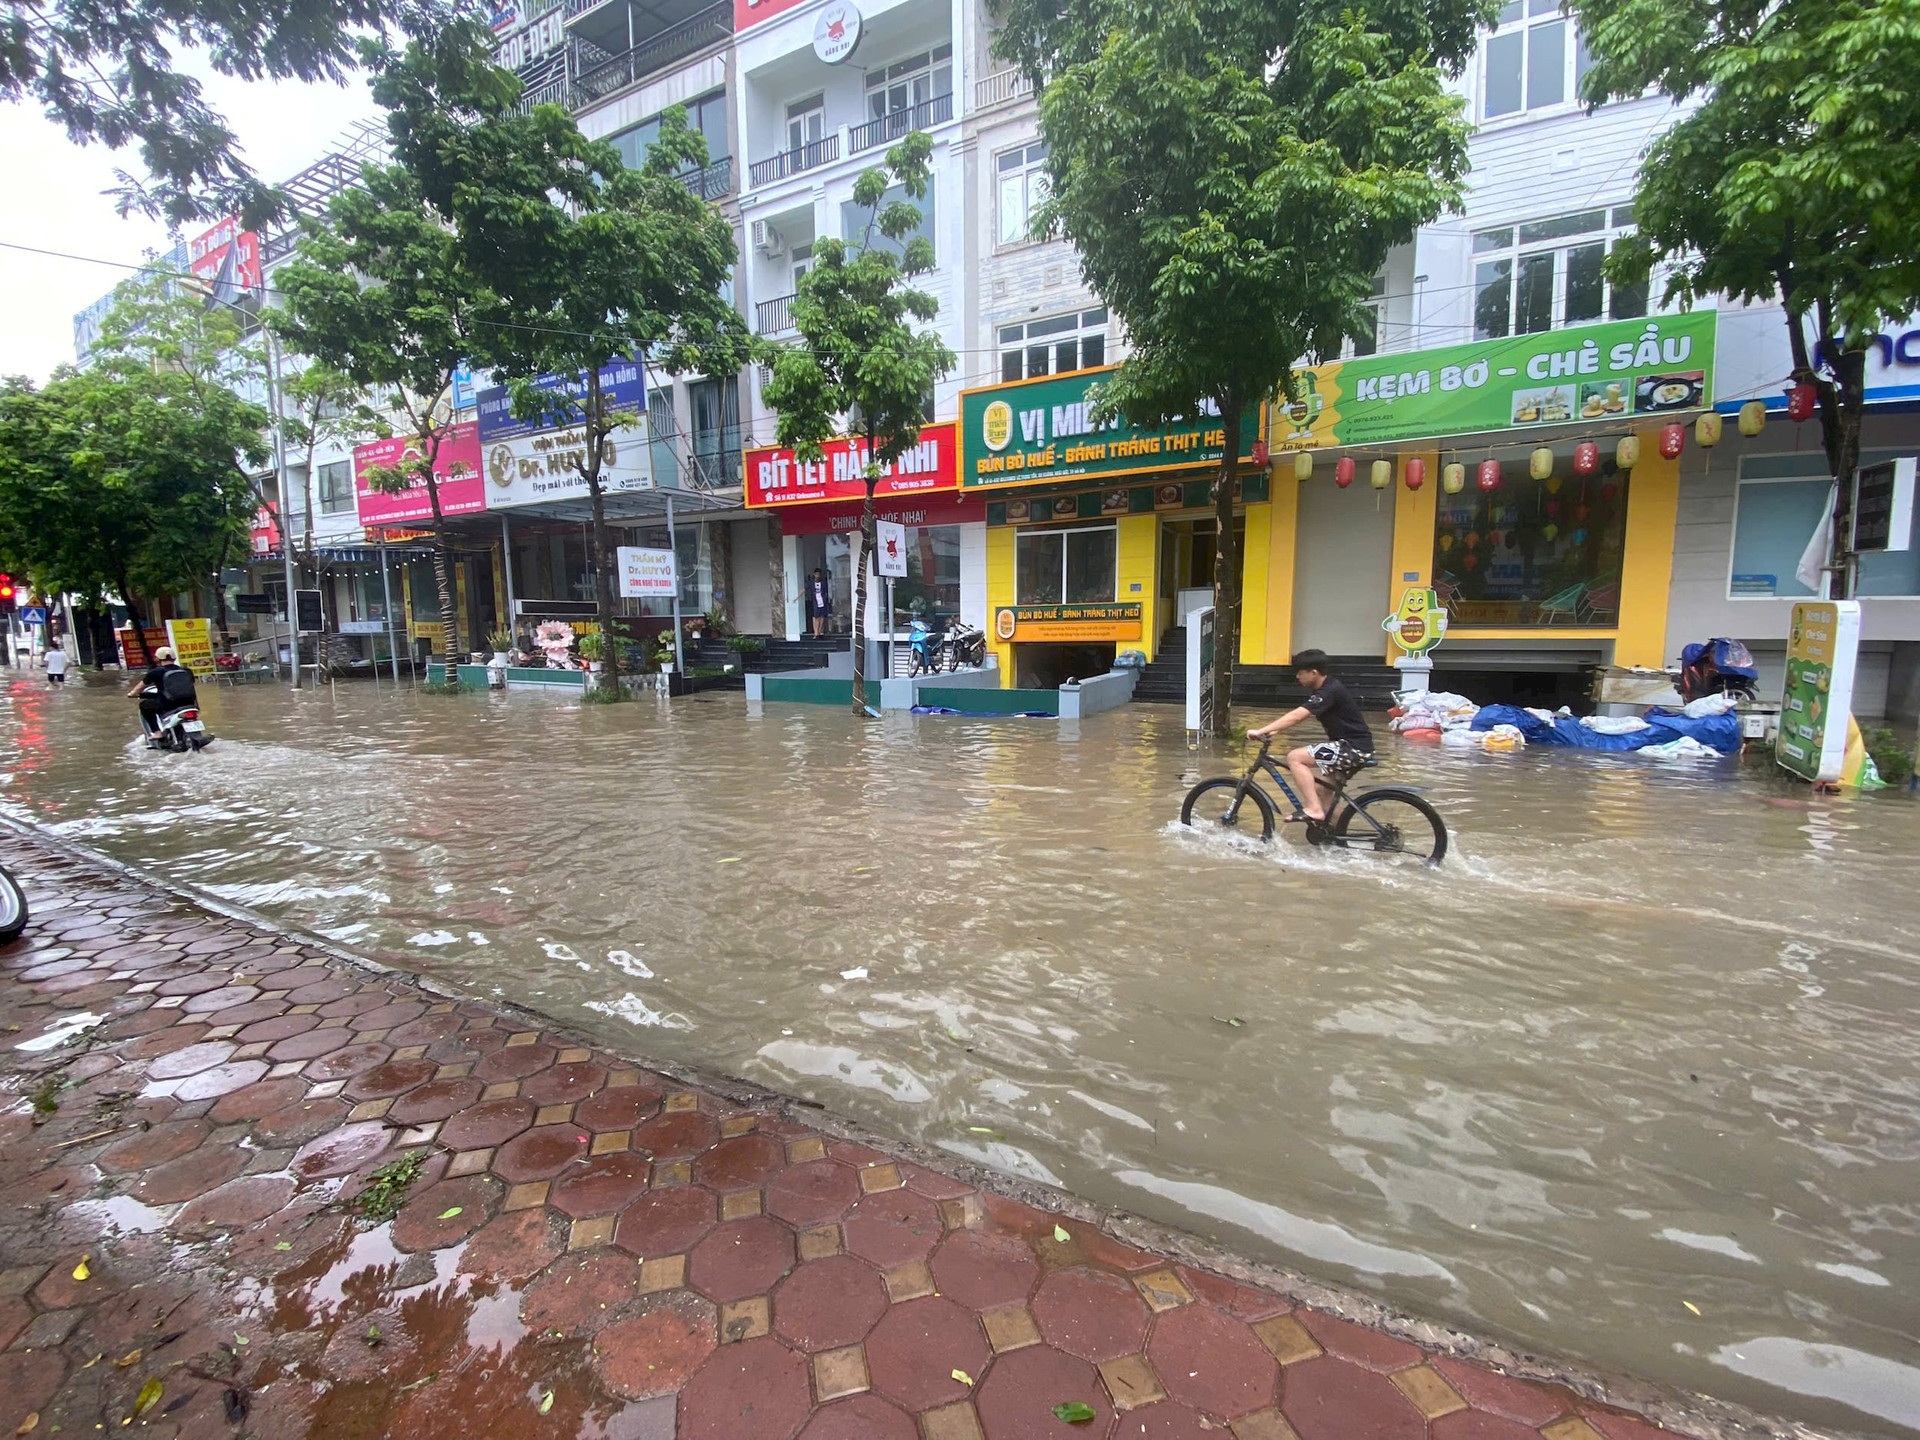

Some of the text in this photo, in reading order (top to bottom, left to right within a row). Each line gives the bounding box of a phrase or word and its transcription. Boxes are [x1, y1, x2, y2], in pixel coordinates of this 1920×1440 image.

[616, 365, 637, 384] HỒNG
[1439, 358, 1489, 391] BƠ
[1526, 338, 1600, 380] CHÈ
[1609, 323, 1692, 371] SẦU
[1019, 408, 1045, 448] VỊ
[518, 457, 545, 479] Dr.
[546, 449, 587, 474] HUY
[758, 452, 789, 490] BÍT
[897, 440, 938, 475] NHI
[976, 453, 1004, 474] BÚN
[1006, 449, 1025, 471] BÒ
[1027, 443, 1056, 468] HUẾ
[1065, 442, 1106, 463] BÁNH
[1108, 434, 1161, 458] TRÁNG
[1163, 431, 1201, 454] THỊT
[1204, 429, 1226, 448] HE
[642, 566, 659, 575] HUY
[1107, 608, 1122, 620] THỊT
[1124, 608, 1139, 617] HEO
